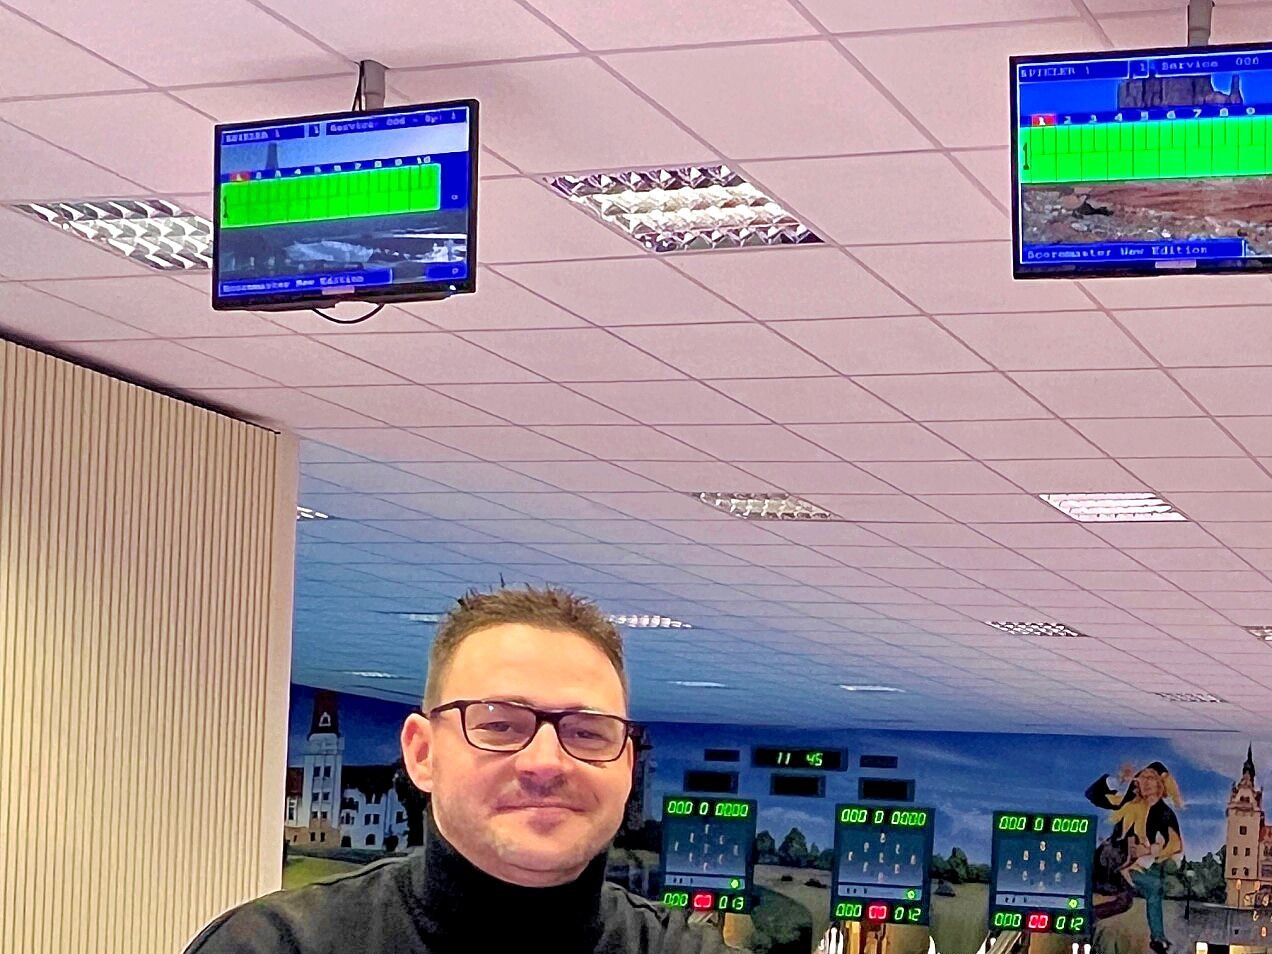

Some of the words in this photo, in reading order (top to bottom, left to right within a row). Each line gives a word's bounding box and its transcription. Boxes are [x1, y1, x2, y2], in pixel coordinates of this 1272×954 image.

[1162, 61, 1218, 70] Service
[1039, 116, 1044, 125] 1
[1064, 116, 1072, 124] 2
[1090, 115, 1097, 123] 3
[1114, 113, 1123, 122] 4
[1141, 112, 1149, 120] 5
[1167, 110, 1176, 119] 6
[1193, 109, 1201, 118] 7
[1220, 108, 1228, 116] 8
[1246, 106, 1255, 115] 9
[1121, 247, 1144, 256] New
[1152, 246, 1207, 254] Edition
[700, 802, 708, 815] 0
[841, 809, 867, 822] 000
[875, 810, 883, 823] 0
[999, 816, 1026, 830] 000
[1034, 818, 1043, 831] 0
[1052, 818, 1088, 833] 0000
[836, 903, 862, 917] 000
[994, 912, 1021, 927] 000
